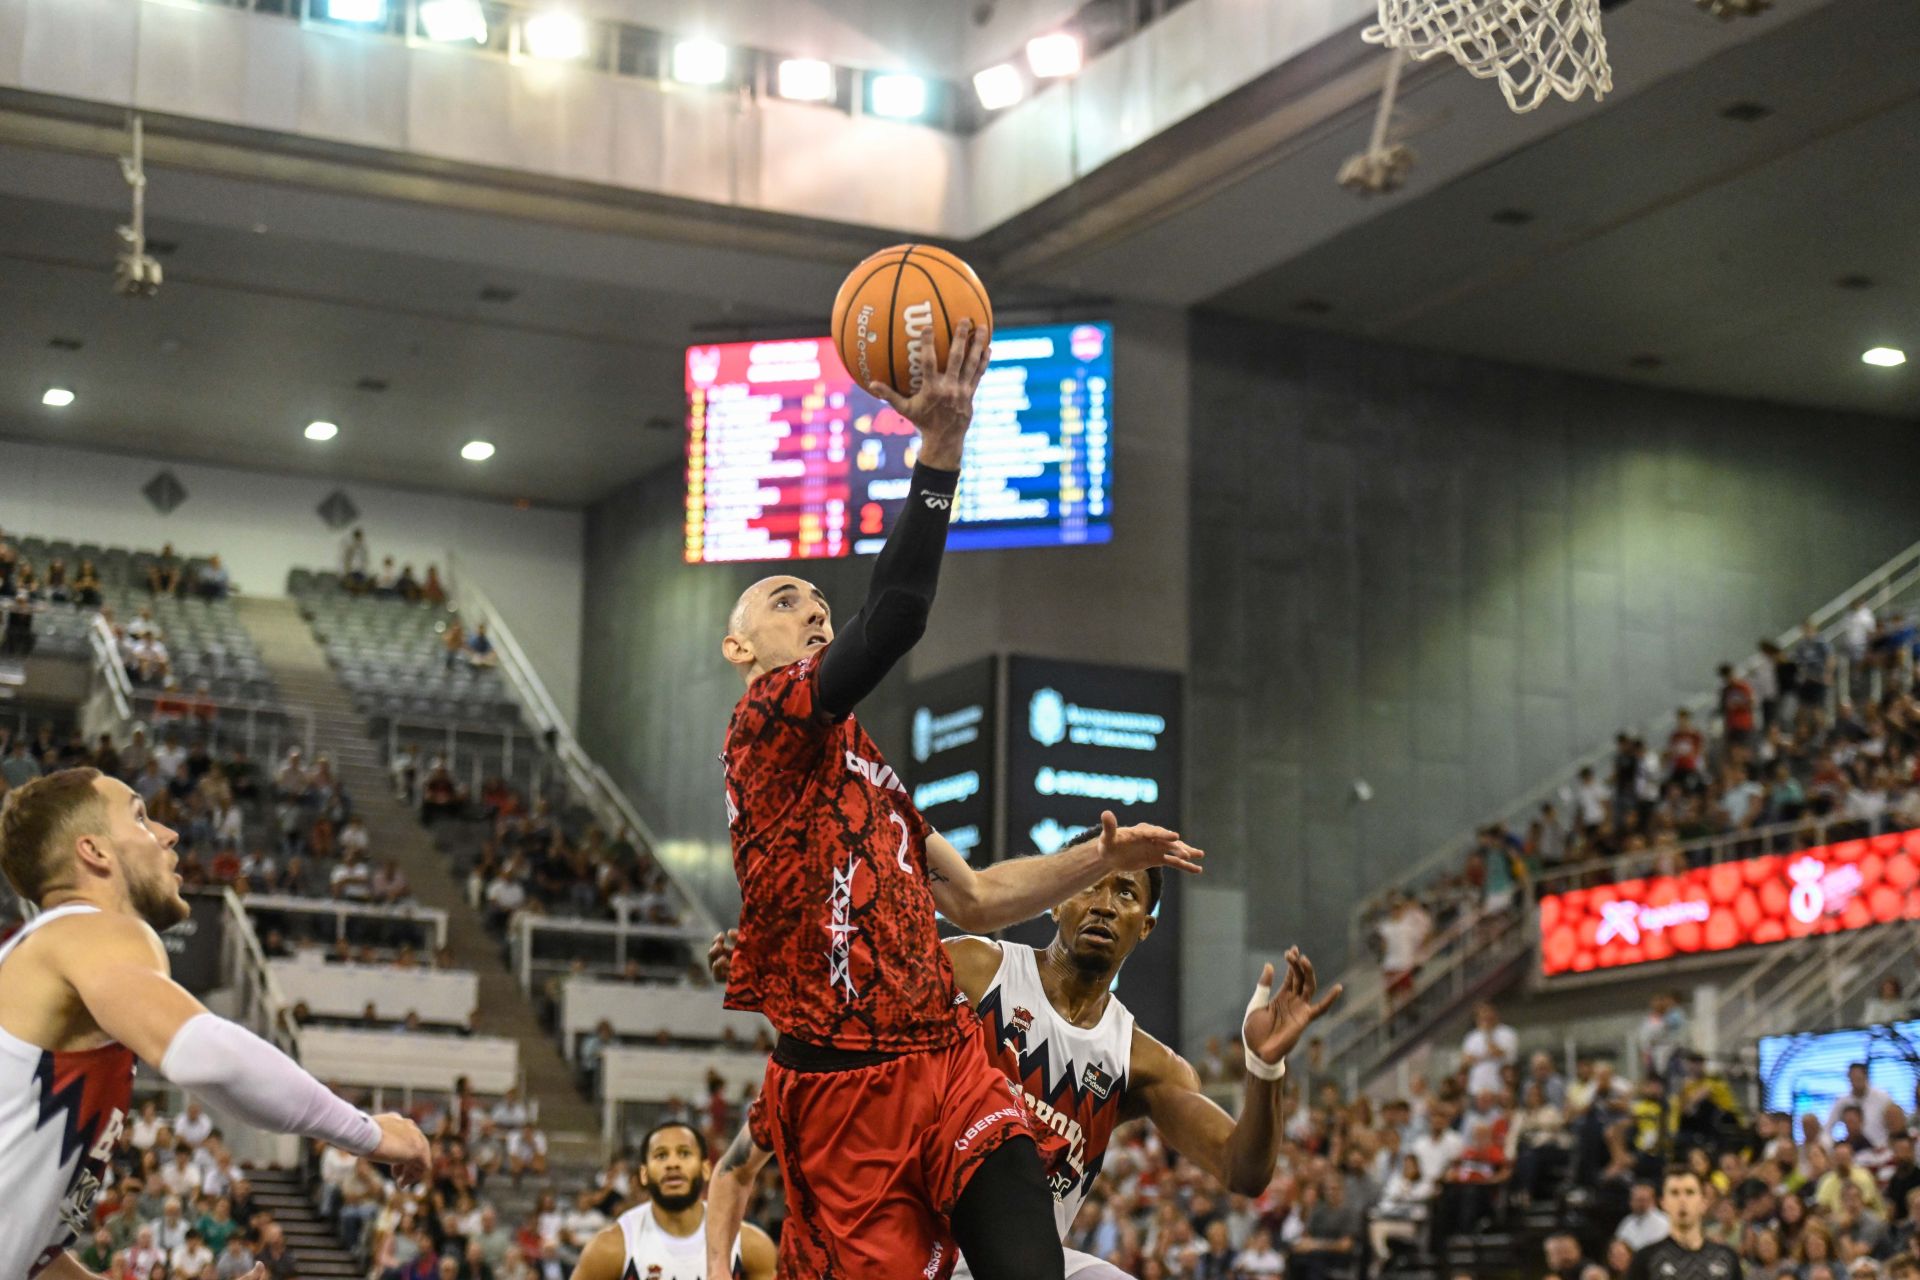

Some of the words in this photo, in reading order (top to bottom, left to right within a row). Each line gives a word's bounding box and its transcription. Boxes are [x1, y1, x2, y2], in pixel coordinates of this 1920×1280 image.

[857, 305, 874, 337] liga
[889, 810, 913, 874] 2
[1084, 1076, 1106, 1095] endesa
[1087, 1069, 1097, 1081] liga
